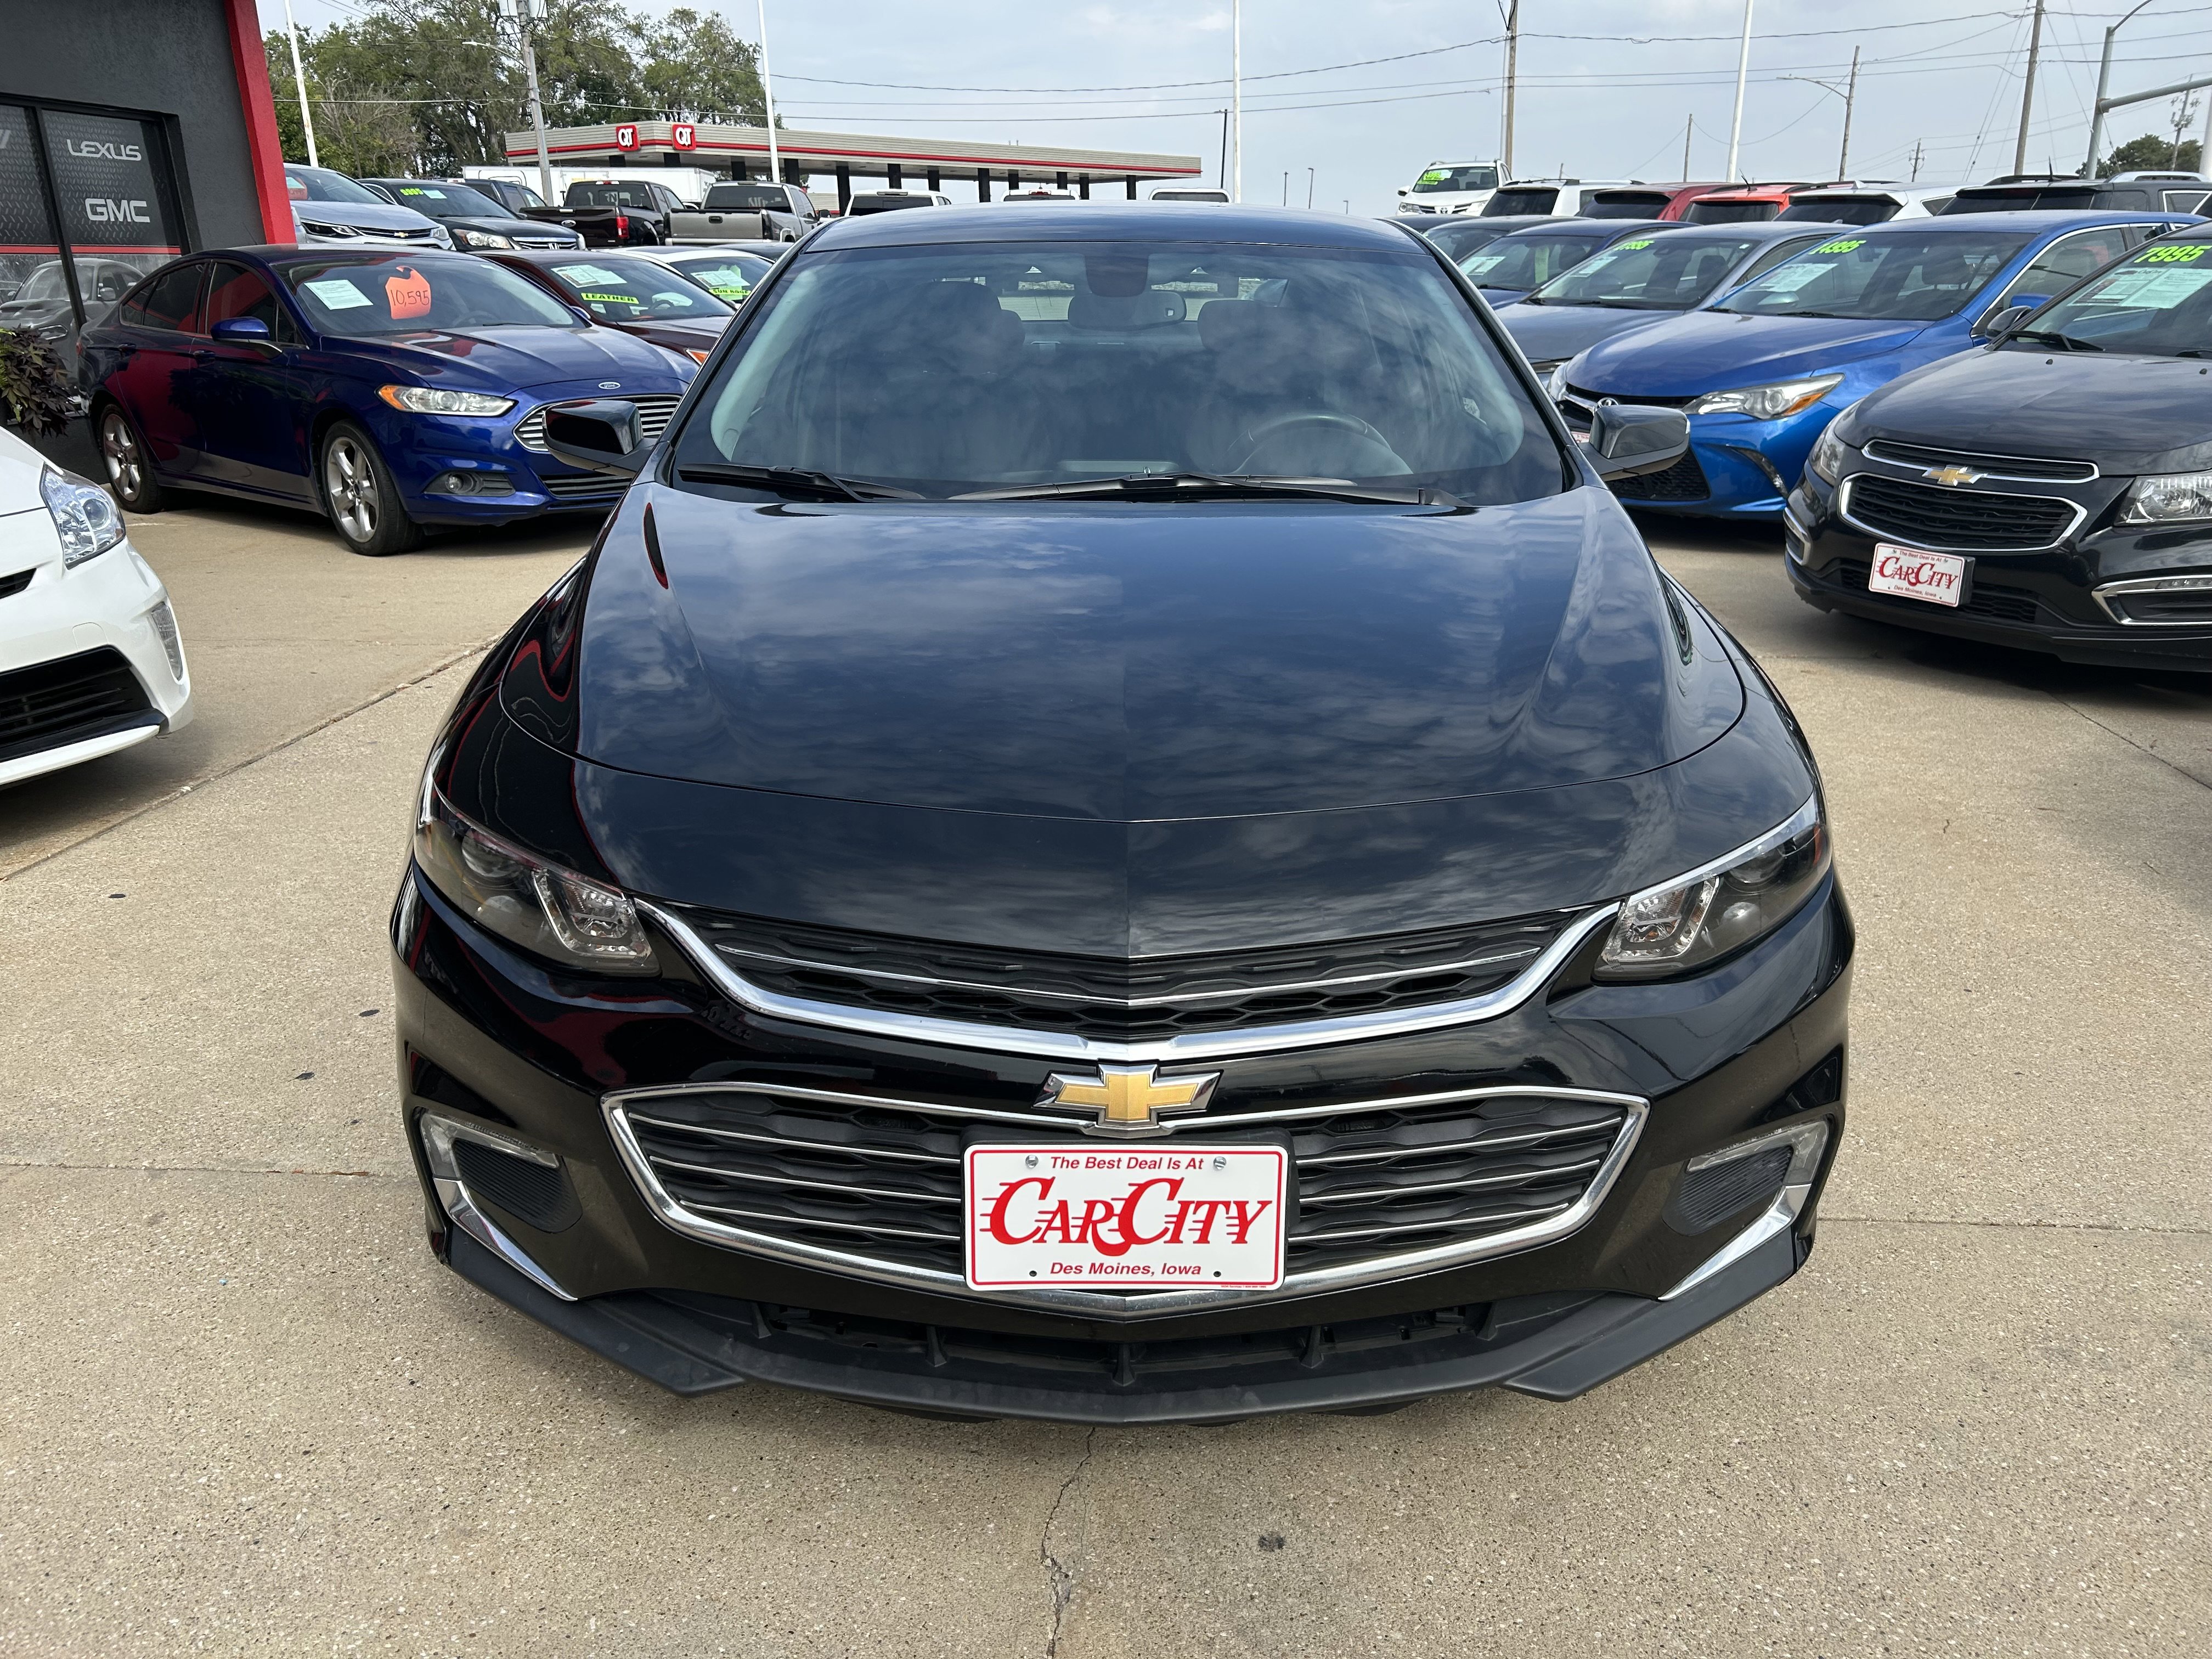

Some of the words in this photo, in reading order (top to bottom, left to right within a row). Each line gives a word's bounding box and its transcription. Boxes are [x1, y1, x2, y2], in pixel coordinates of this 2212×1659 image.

[618, 127, 634, 148] QT
[675, 127, 692, 146] QT
[66, 138, 142, 161] LEXUS
[84, 198, 150, 223] GMC
[2134, 245, 2212, 263] 7995
[390, 289, 430, 307] 10,595
[585, 293, 635, 302] LEATHER
[1051, 1156, 1080, 1169] The
[1085, 1156, 1122, 1170] Best
[1126, 1156, 1162, 1170] Deal
[1167, 1157, 1181, 1170] Is
[1184, 1157, 1204, 1170] At
[1049, 1262, 1084, 1275] Des
[1088, 1262, 1155, 1277] Moines,
[1160, 1263, 1201, 1275] Iowa
